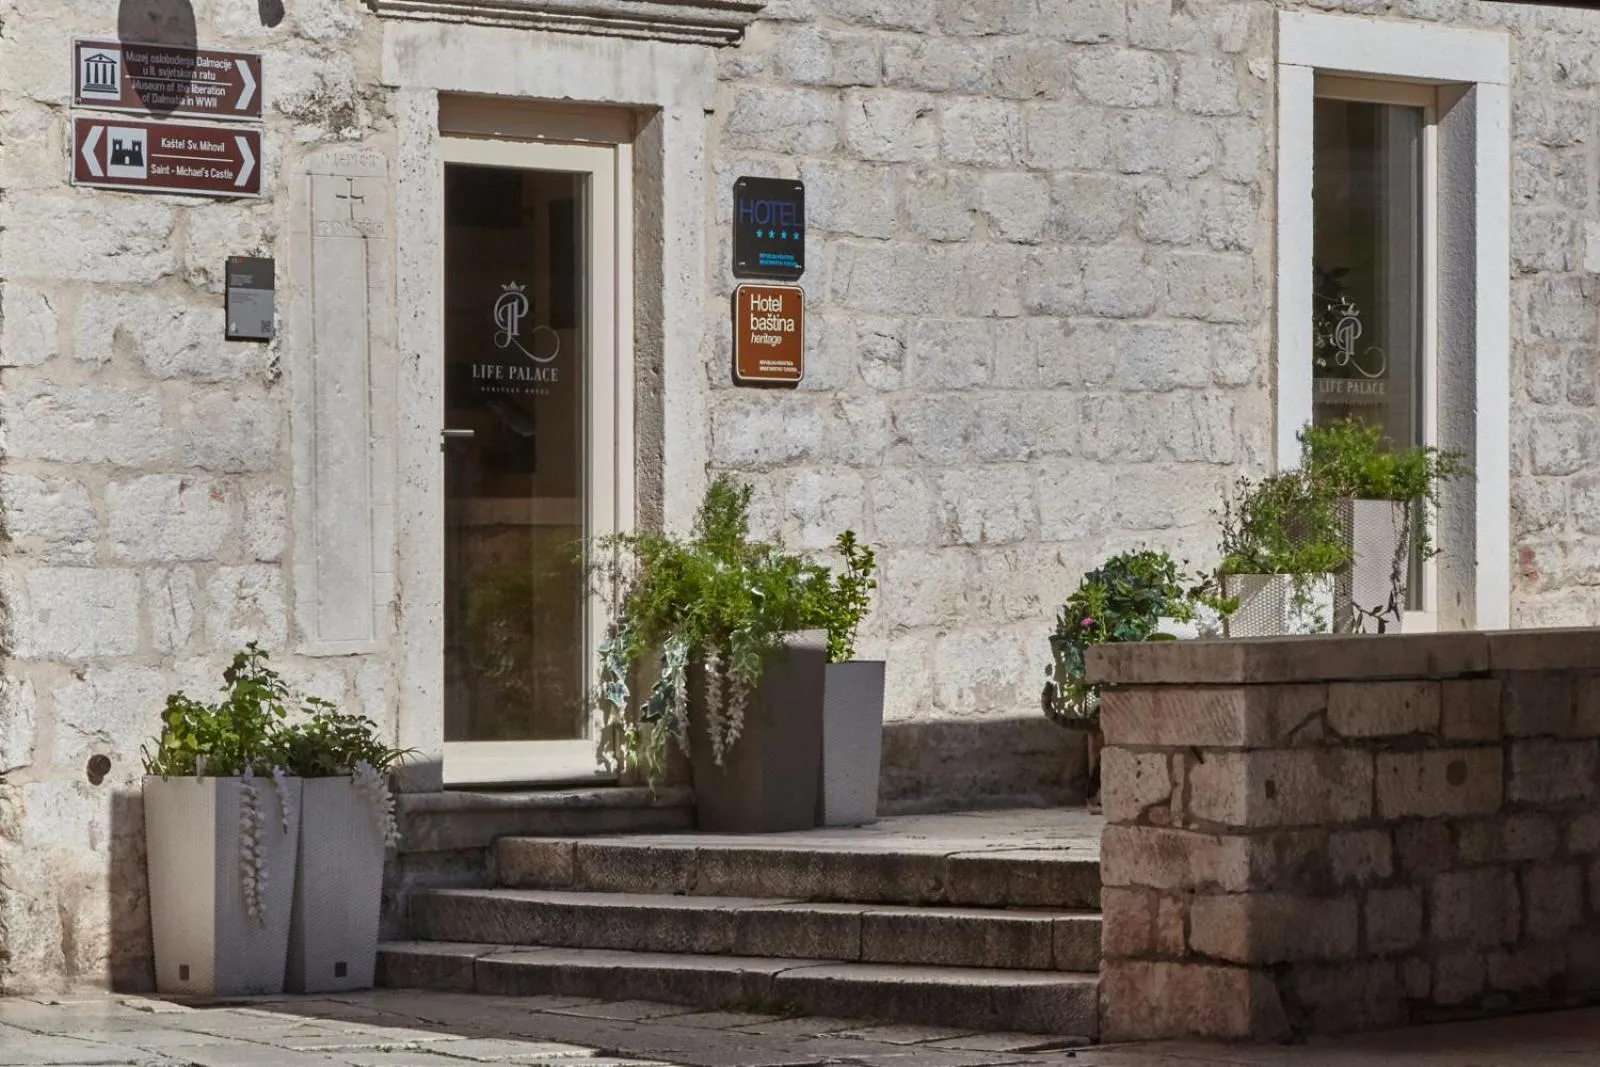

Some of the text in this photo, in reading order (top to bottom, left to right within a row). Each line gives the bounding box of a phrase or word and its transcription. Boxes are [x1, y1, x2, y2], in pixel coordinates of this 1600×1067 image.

[126, 51, 149, 64] Muzej
[197, 57, 232, 70] Dalmacije
[199, 72, 216, 80] ratu
[132, 80, 165, 92] Museum
[166, 83, 175, 92] of
[191, 83, 226, 96] liberation
[142, 94, 151, 103] of
[186, 95, 194, 105] in
[195, 96, 217, 107] WWII
[161, 137, 225, 152] Kaštel Sv. Mihovil
[151, 164, 169, 174] Saint
[176, 166, 209, 177] Michael's
[210, 168, 233, 179] Castle
[740, 198, 802, 226] HOTEL
[751, 293, 782, 312] Hotel
[751, 313, 794, 332] baština
[751, 332, 782, 347] heritage
[472, 364, 559, 382] LIFE PALACE
[1319, 381, 1385, 395] LIFE PALACE
